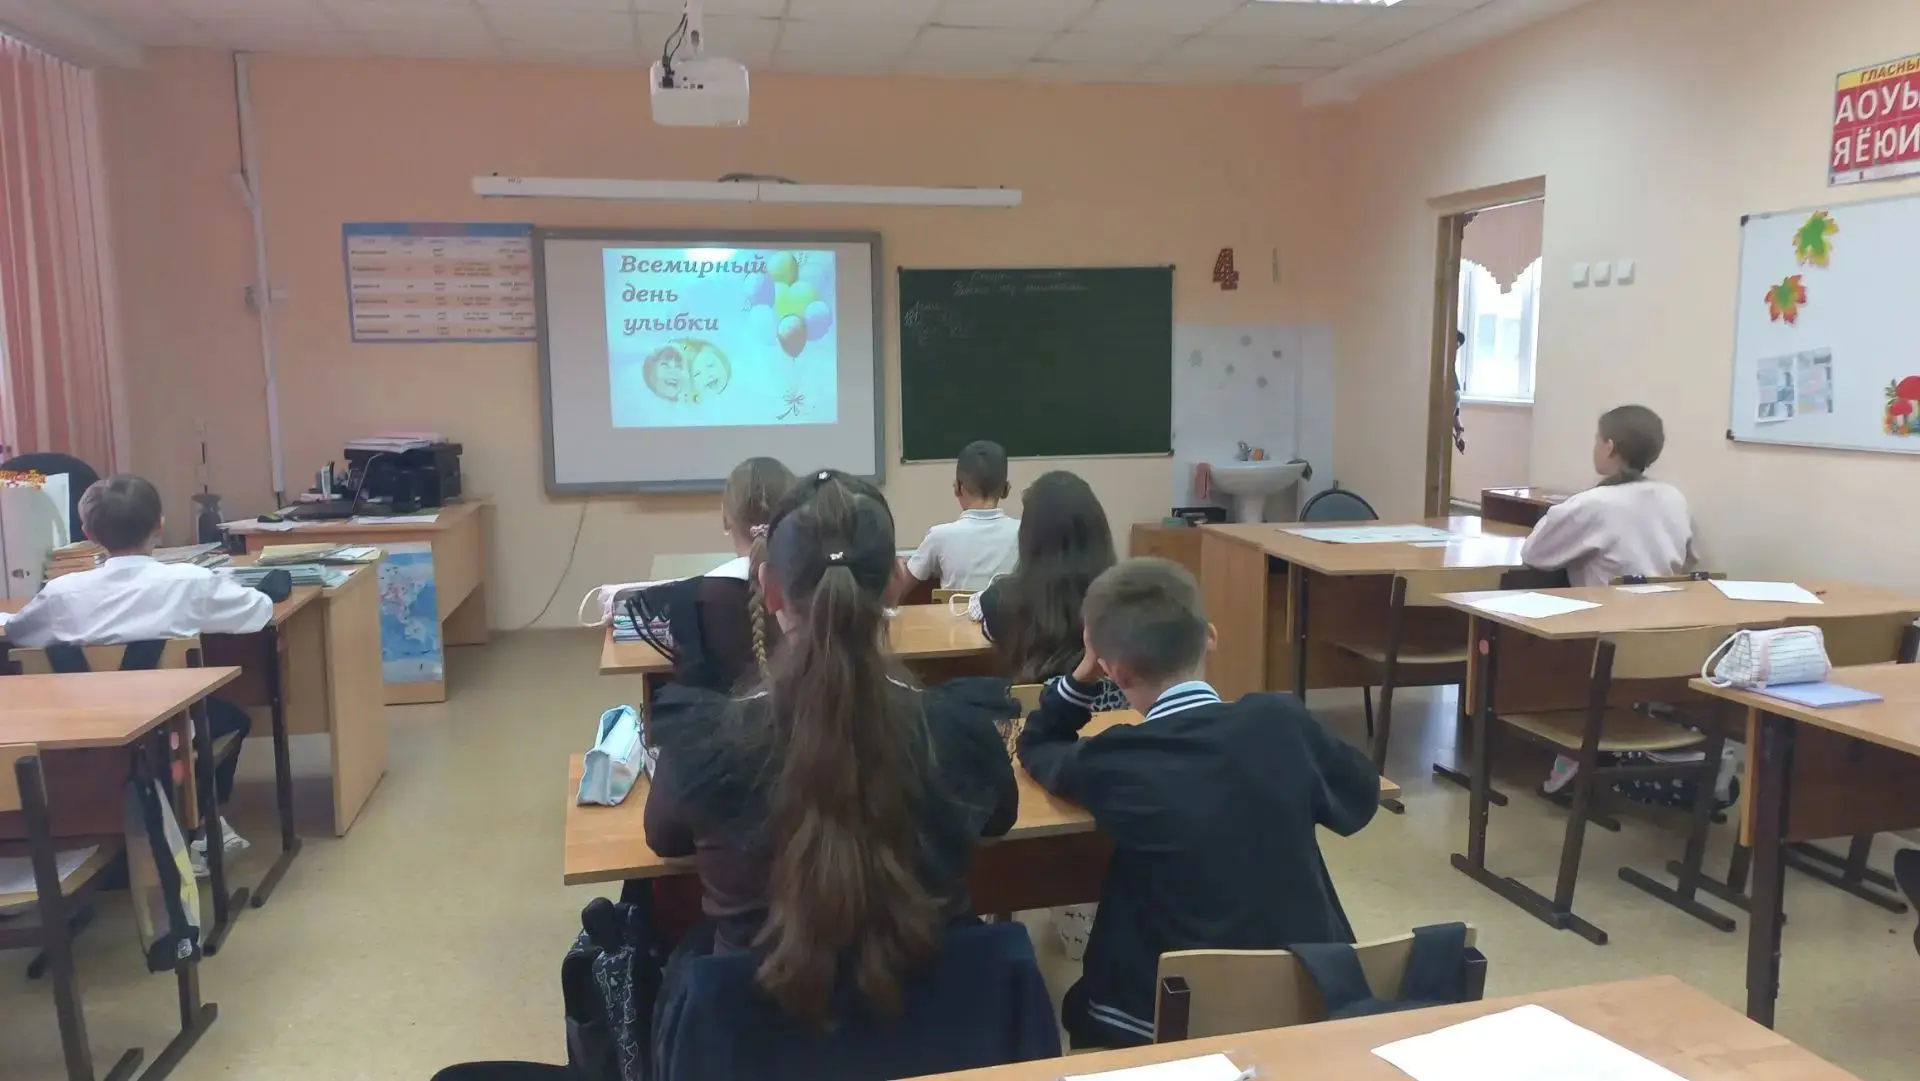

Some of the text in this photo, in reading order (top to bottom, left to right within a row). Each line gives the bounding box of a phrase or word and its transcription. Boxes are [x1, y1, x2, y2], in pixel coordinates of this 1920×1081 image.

[619, 254, 767, 278] Всемирный
[1212, 248, 1239, 290] 4
[622, 283, 678, 302] день
[623, 312, 718, 336] улыбки
